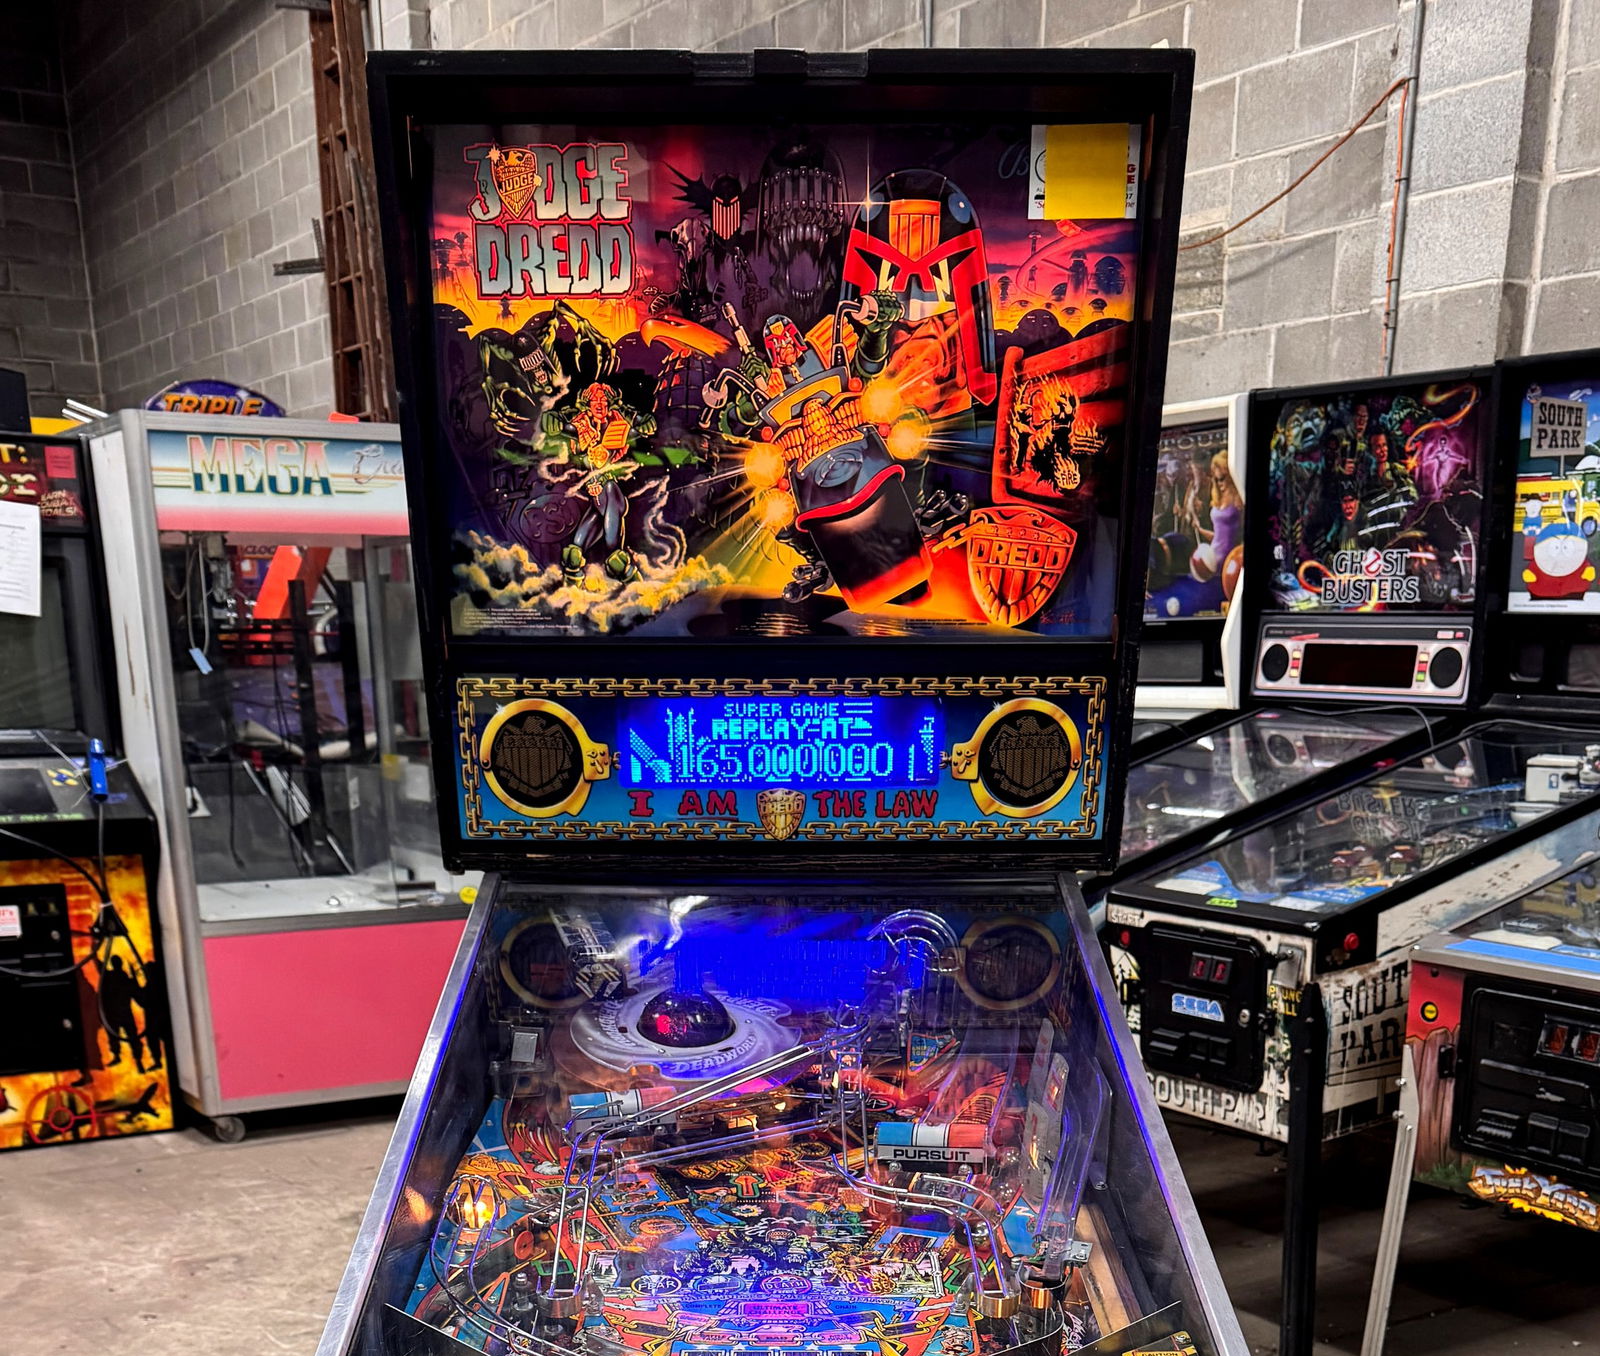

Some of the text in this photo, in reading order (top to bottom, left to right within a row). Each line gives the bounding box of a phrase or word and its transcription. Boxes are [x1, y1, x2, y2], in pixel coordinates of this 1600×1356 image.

[500, 173, 533, 193] JUDGE
[473, 221, 636, 299] DREDD
[162, 393, 263, 416] TRIPLE
[1539, 402, 1583, 427] SOUTH
[1536, 428, 1581, 448] PARK
[187, 435, 335, 496] MEGA
[972, 538, 1068, 570] DREDD
[1322, 575, 1421, 603] BUSTERS
[724, 702, 839, 717] SUPER GAME
[712, 717, 854, 740] REPLAY AT
[629, 790, 654, 816] I
[678, 789, 739, 816] AM
[812, 790, 867, 818] THE
[874, 789, 938, 819] LAW
[1172, 994, 1222, 1016] SEGA
[1341, 962, 1409, 1025] SOUT
[1340, 1016, 1403, 1068] PAR
[893, 1149, 970, 1161] PURSUIT
[638, 1280, 677, 1292] FEAR
